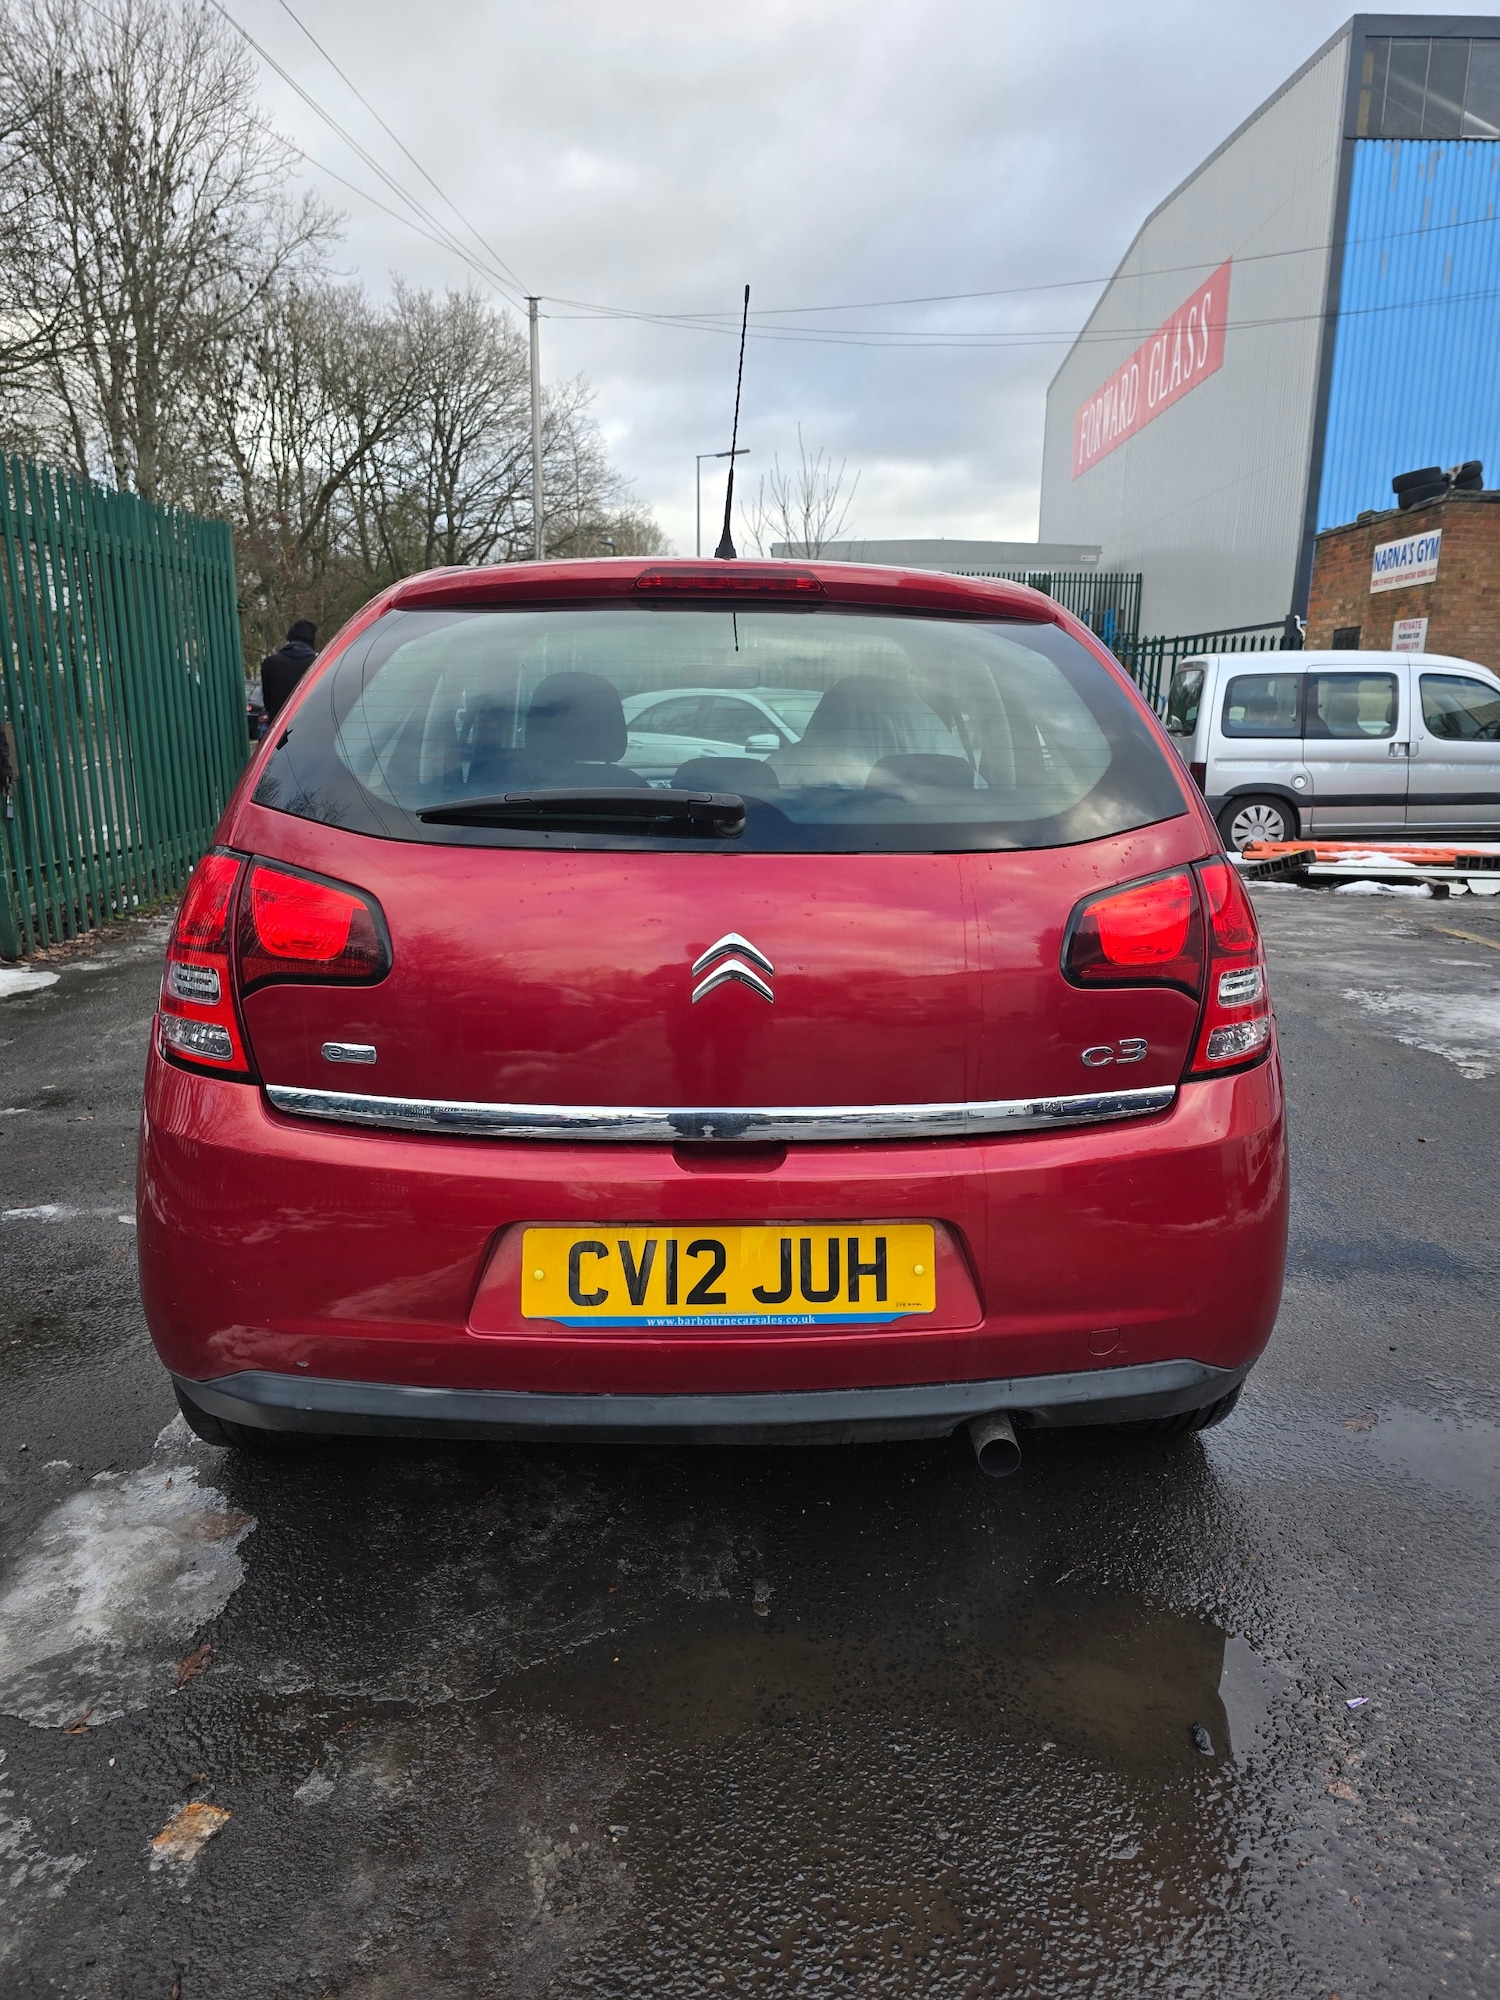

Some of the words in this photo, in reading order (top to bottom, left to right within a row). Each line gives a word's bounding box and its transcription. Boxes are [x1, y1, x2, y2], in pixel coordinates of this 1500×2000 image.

[1079, 363, 1139, 464] FORWARD
[1148, 289, 1212, 408] GLASS
[1417, 536, 1440, 563] GYM
[1398, 620, 1422, 630] PRIVATE
[1081, 1038, 1148, 1067] C3
[568, 1239, 727, 1306] CV12
[752, 1237, 887, 1302] JUH
[646, 1314, 816, 1327] www.barbournecarsales.co.uk
